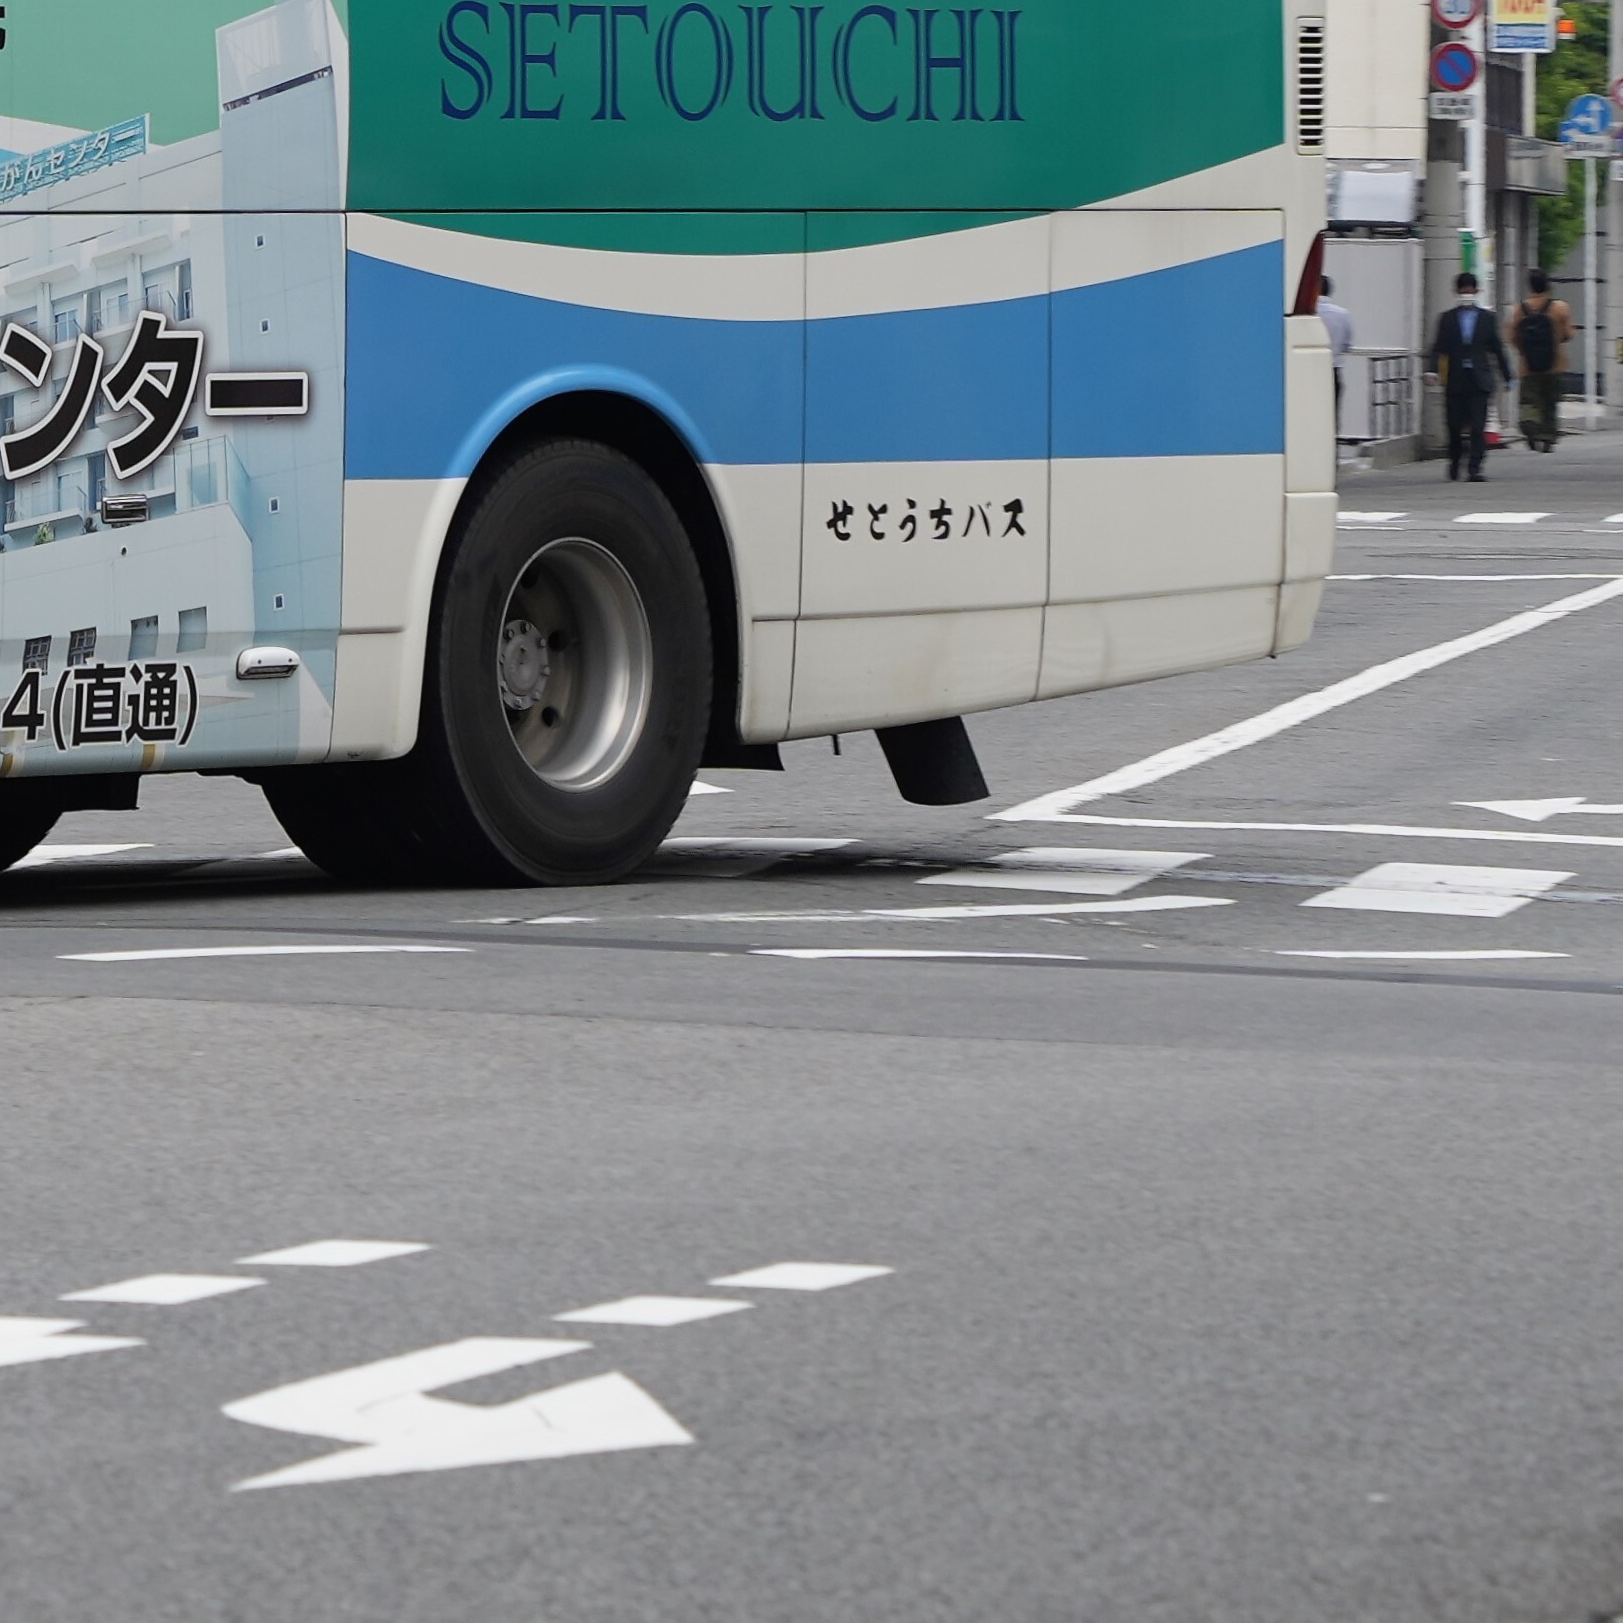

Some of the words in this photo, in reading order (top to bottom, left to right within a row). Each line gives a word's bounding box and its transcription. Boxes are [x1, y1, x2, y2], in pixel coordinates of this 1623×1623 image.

[438, 0, 1026, 122] SETOUCHI
[824, 496, 1028, 544] せとうちバス
